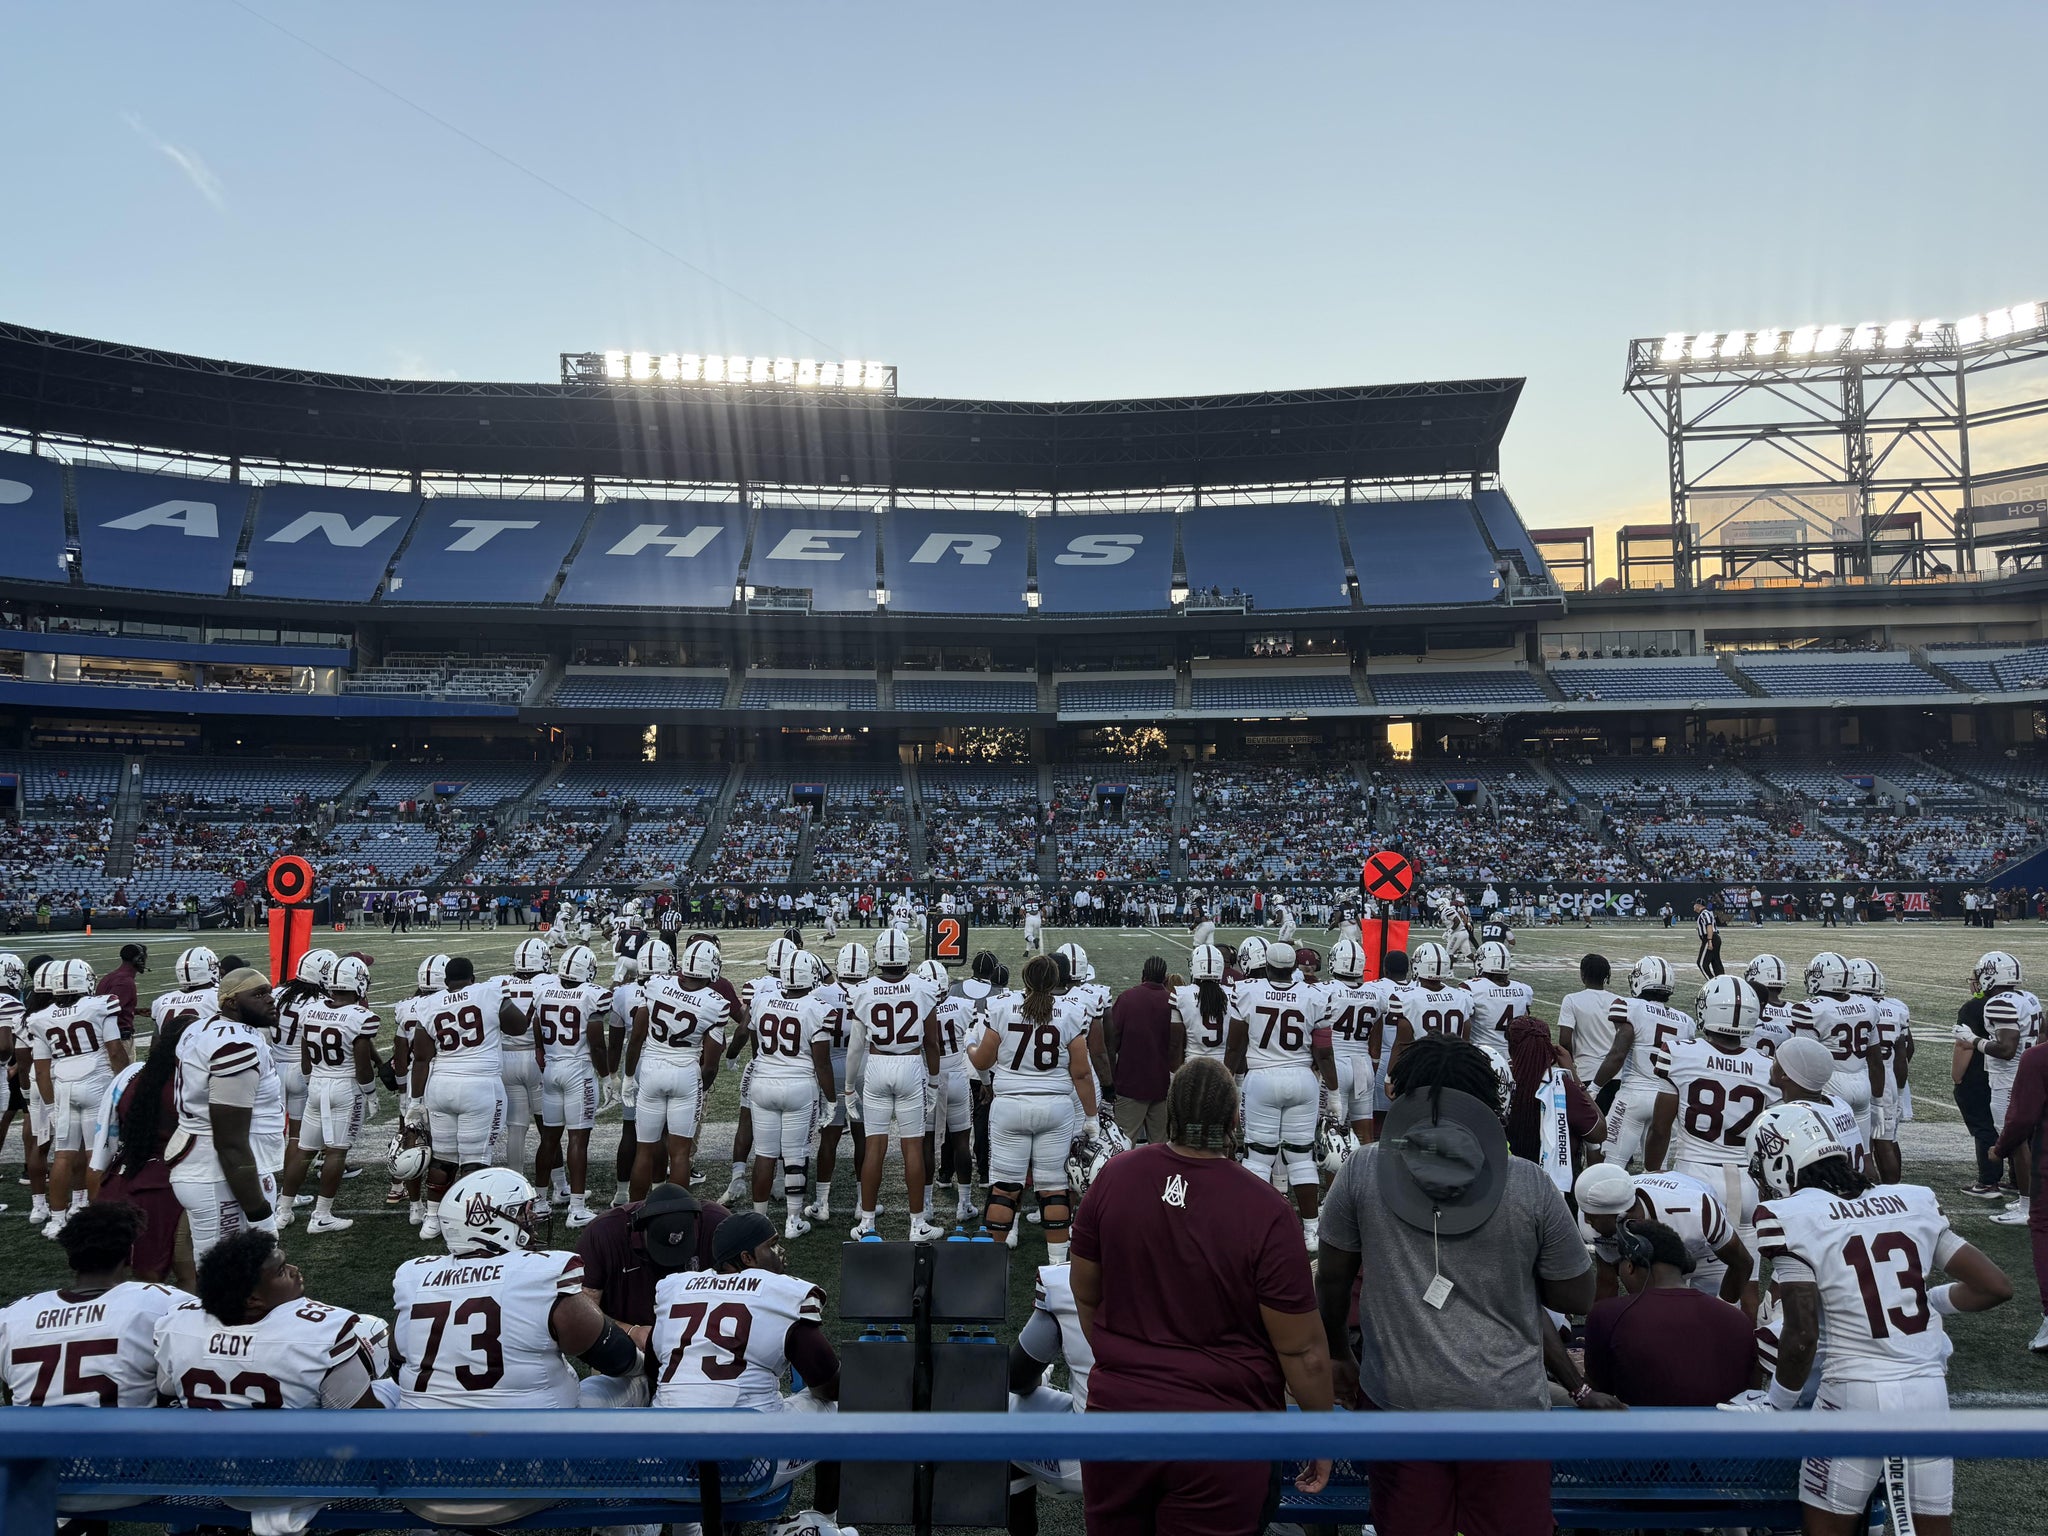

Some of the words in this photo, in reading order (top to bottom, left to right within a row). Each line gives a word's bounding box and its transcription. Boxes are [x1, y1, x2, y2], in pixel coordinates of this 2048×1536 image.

[2008, 502, 2047, 516] HOS
[1247, 736, 1285, 744] BEVERAGE
[1287, 736, 1322, 744] EXPRESS
[896, 908, 908, 919] 43
[1025, 902, 1039, 912] 55
[624, 934, 638, 950] 4
[937, 918, 960, 956] 2
[1482, 925, 1501, 937] 50
[170, 994, 204, 1005] WILLIAMS
[443, 991, 469, 1006] EVANS
[544, 989, 584, 1000] BRADSHAW
[661, 986, 702, 1008] CAMPBELL
[873, 984, 911, 996] BOZEMAN
[1265, 990, 1297, 1003] COOPER
[1345, 989, 1377, 1001] THOMPSON
[1426, 993, 1454, 1003] BUTLER
[1488, 987, 1524, 998] LITTLEFIELD
[52, 1005, 79, 1018] SCOTT
[306, 1009, 338, 1022] SANDERS
[339, 1013, 347, 1023] III
[767, 999, 800, 1012] MERRELL
[1645, 1004, 1680, 1022] EDWARDS
[1835, 1003, 1866, 1017] THOMAS
[213, 1026, 236, 1038] 71
[433, 1004, 485, 1051] 69
[540, 1004, 581, 1046] 59
[651, 999, 699, 1048] 52
[870, 1000, 919, 1046] 92
[1255, 1005, 1305, 1051] 76
[1332, 1004, 1377, 1041] 46
[46, 1020, 100, 1059] 30
[303, 1023, 345, 1066] 58
[758, 1012, 801, 1057] 99
[1830, 1020, 1873, 1061] 36
[1008, 1022, 1061, 1071] 78
[1706, 1056, 1753, 1076] ANGLIN
[491, 1099, 503, 1131] ALABAMA
[1605, 1115, 1624, 1145] ALABAMA
[1616, 1099, 1628, 1117] A&M
[1684, 1078, 1765, 1147] 82
[1556, 1112, 1568, 1167] POWERADE
[1812, 1125, 1821, 1133] 13
[1828, 1193, 1907, 1222] JACKSON
[421, 1264, 505, 1288] LAWRENCE
[684, 1276, 763, 1293] CRENSHAW
[1841, 1230, 1931, 1340] 13
[36, 1303, 107, 1330] GRIFFIN
[208, 1333, 254, 1357] CLOY
[410, 1296, 505, 1392] 73
[661, 1302, 753, 1383] 79
[11, 1338, 119, 1408] 75
